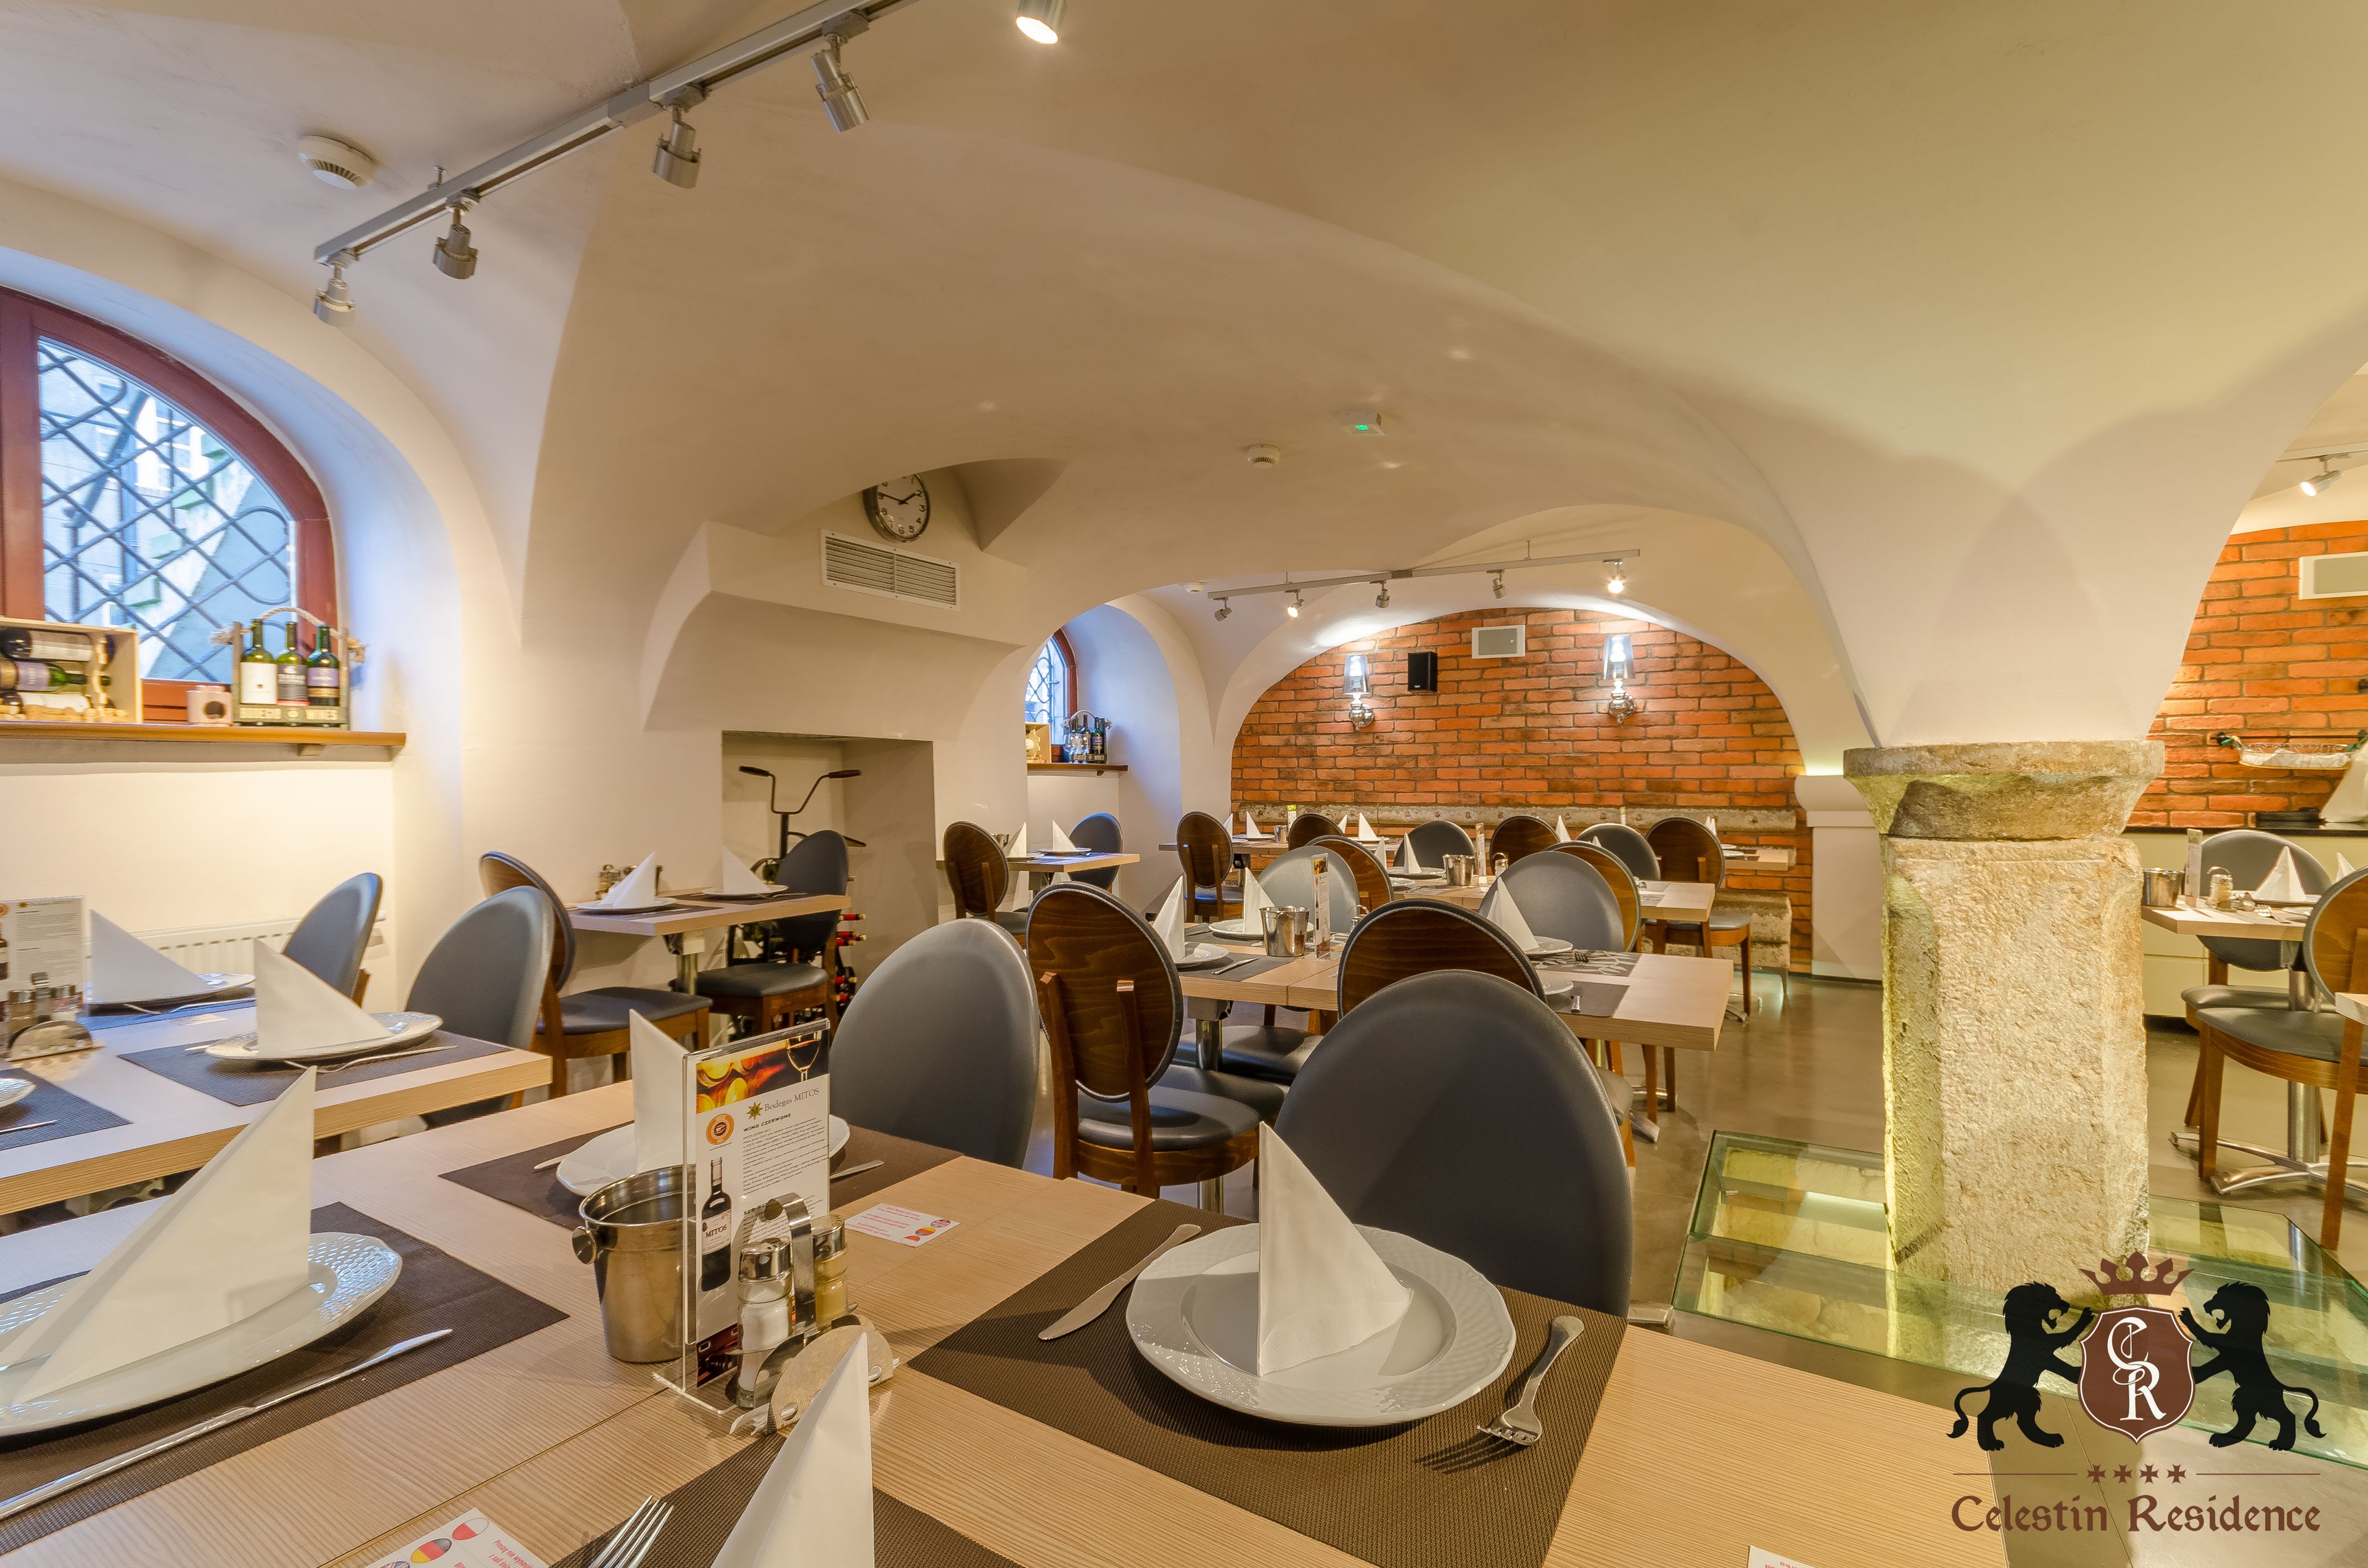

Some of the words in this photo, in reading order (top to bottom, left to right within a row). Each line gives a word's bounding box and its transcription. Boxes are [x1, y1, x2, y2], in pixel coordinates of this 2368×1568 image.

[916, 490, 923, 498] 2
[881, 507, 887, 515] 8
[919, 504, 925, 512] 3
[888, 519, 894, 528] 7
[898, 527, 905, 535] 6
[908, 525, 915, 533] 5
[765, 1100, 792, 1111] Bodegas
[794, 1088, 820, 1102] MITOS
[761, 1113, 791, 1127] CZERWONE
[705, 1224, 727, 1238] MITOS
